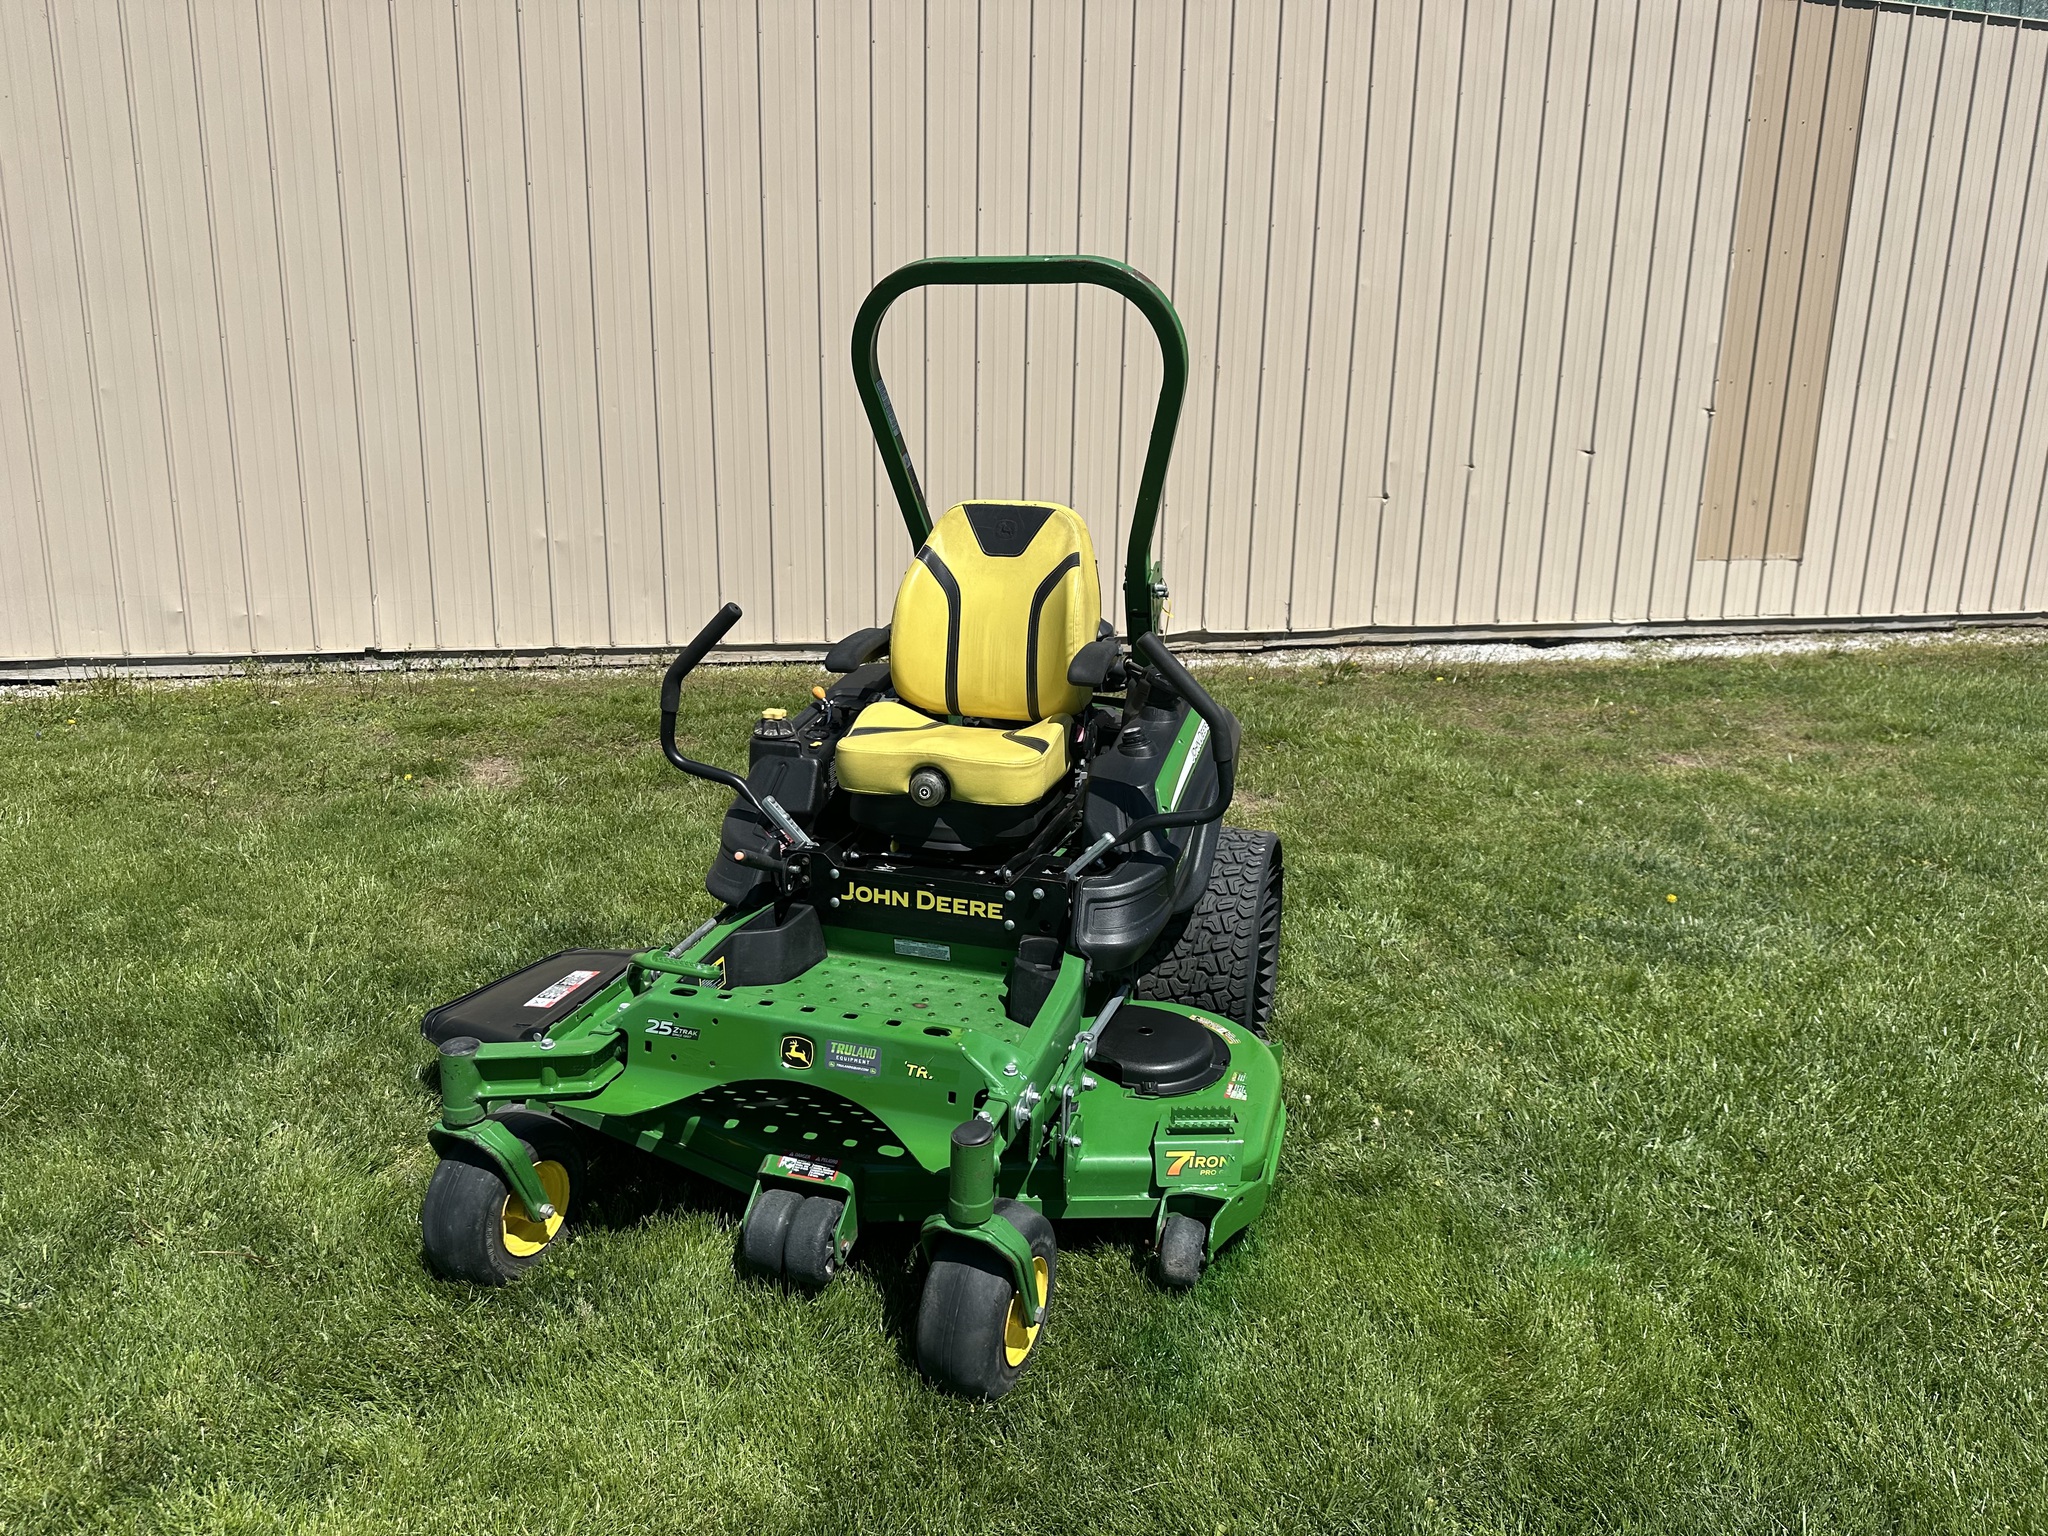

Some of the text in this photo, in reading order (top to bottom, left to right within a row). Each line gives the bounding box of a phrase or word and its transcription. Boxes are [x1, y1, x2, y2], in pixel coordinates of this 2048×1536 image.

[841, 881, 1003, 920] JOHN DEERE
[645, 1019, 698, 1036] 25 ZTRAK
[830, 1042, 877, 1060] TRULAND
[836, 1055, 870, 1065] EQUIPMENT
